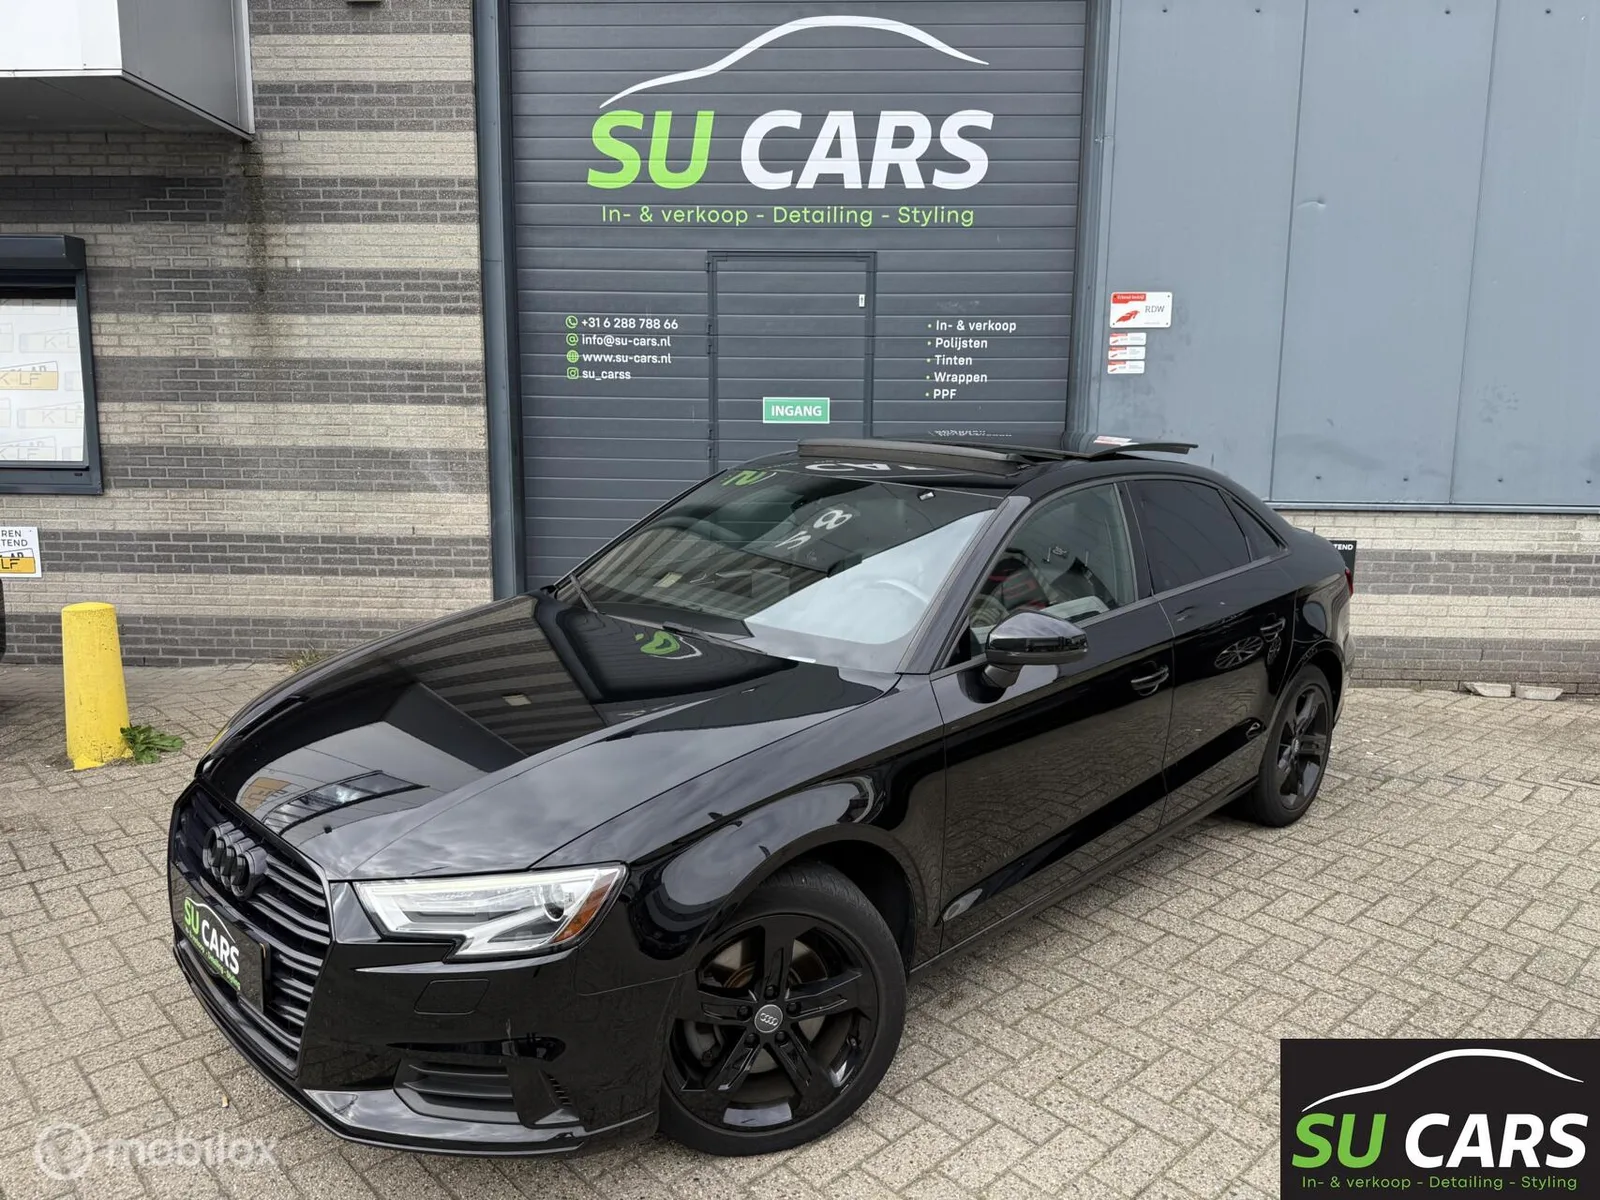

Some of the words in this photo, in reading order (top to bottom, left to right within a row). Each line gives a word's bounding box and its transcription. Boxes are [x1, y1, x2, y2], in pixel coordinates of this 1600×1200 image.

[587, 110, 715, 189] SU
[740, 109, 994, 190] CARS
[602, 205, 631, 223] In-
[639, 205, 653, 222] &
[663, 205, 748, 228] verkoop
[773, 206, 873, 228] Detailing
[898, 206, 975, 227] Styling
[1144, 305, 1166, 313] RDW
[581, 317, 600, 328] +31
[603, 318, 611, 328] 6
[614, 318, 636, 329] 288
[639, 318, 661, 329] 788
[663, 319, 679, 329] 66
[936, 320, 953, 331] In-
[956, 320, 965, 331] &
[968, 320, 1017, 333] verkoop
[581, 334, 671, 347] info@su-cars.nl
[935, 337, 988, 350] Polijsten
[582, 353, 672, 364] www.su-cars.nl
[934, 354, 973, 365] Tinten
[582, 370, 632, 381] su_carss
[933, 371, 988, 384] Wrappen
[933, 388, 957, 399] PPF
[771, 405, 823, 417] INGANG
[1, 529, 22, 538] REN
[1, 539, 28, 547] TEND
[184, 899, 200, 935] SU
[201, 919, 240, 975] CARS
